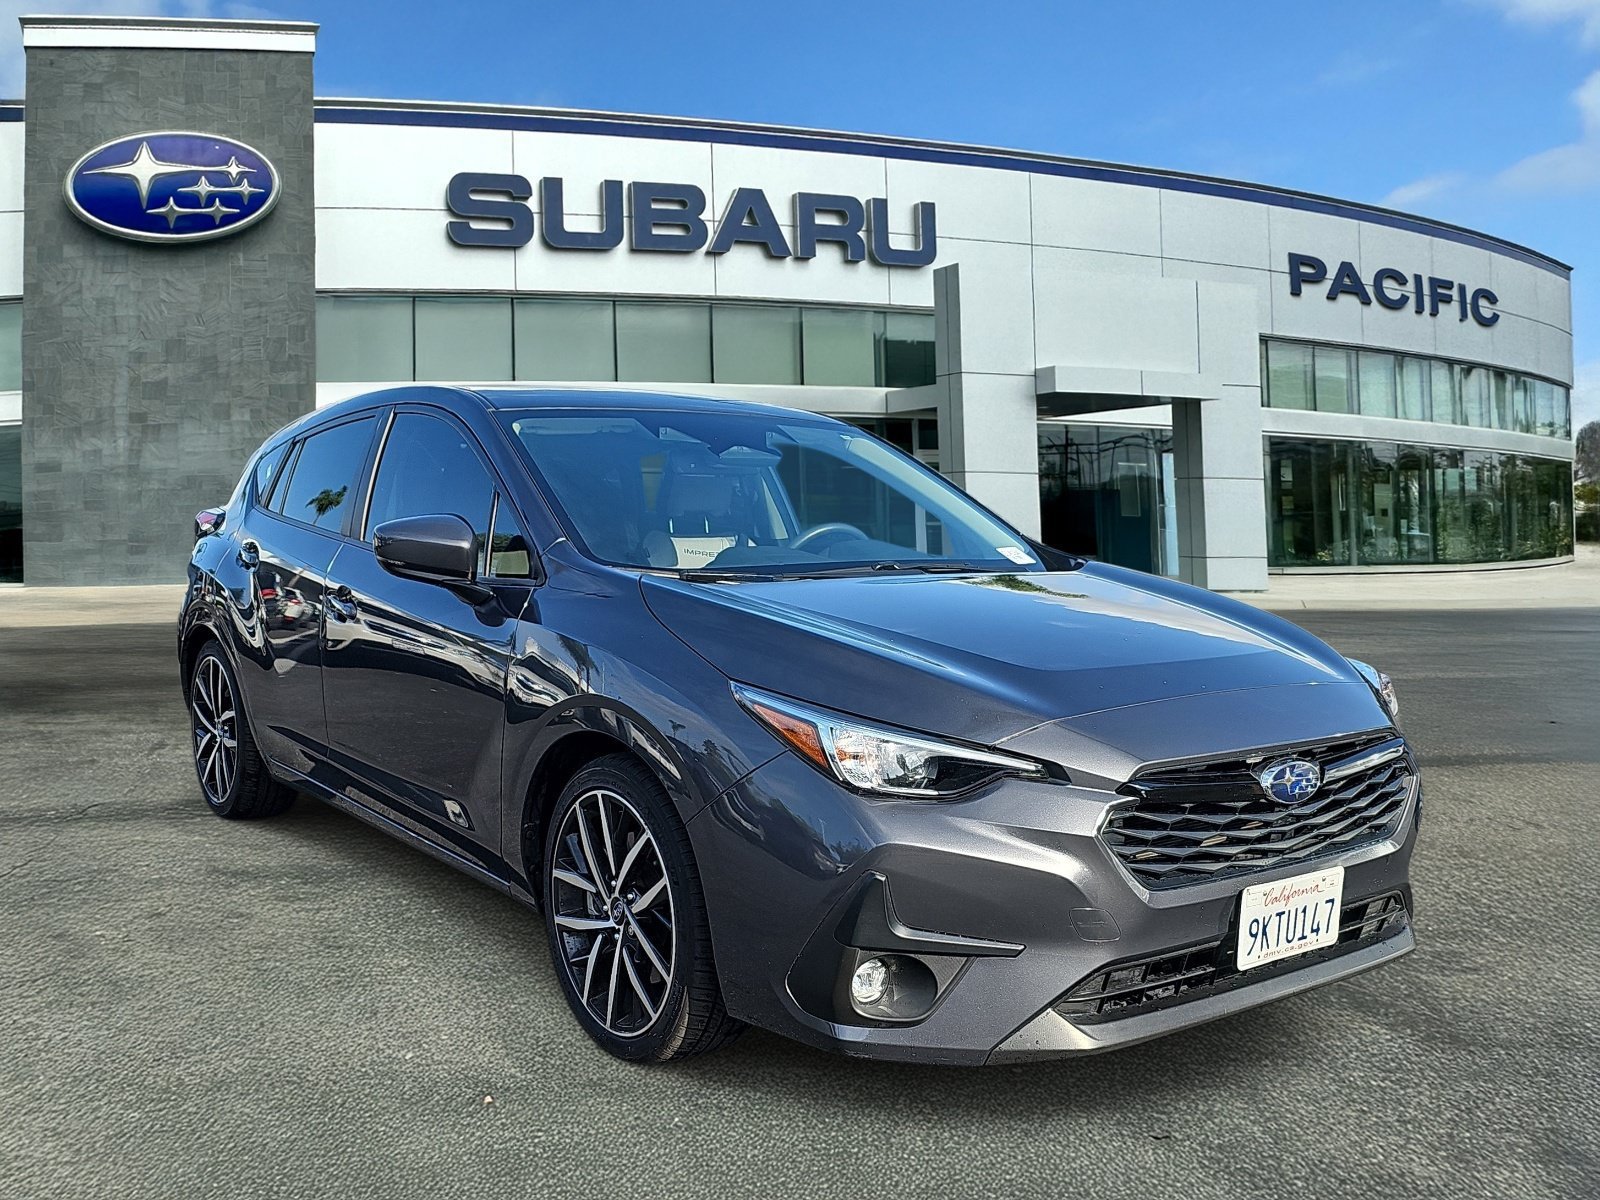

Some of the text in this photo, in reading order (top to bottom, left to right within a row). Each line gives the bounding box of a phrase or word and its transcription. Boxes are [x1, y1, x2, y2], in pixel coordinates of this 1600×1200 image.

[446, 172, 937, 267] SUBARU
[1288, 252, 1500, 326] PACIFIC
[683, 548, 719, 558] IMPRE
[1264, 883, 1325, 907] California
[1247, 898, 1335, 956] 9KTU147
[1263, 940, 1314, 959] dmv.ca.gov
